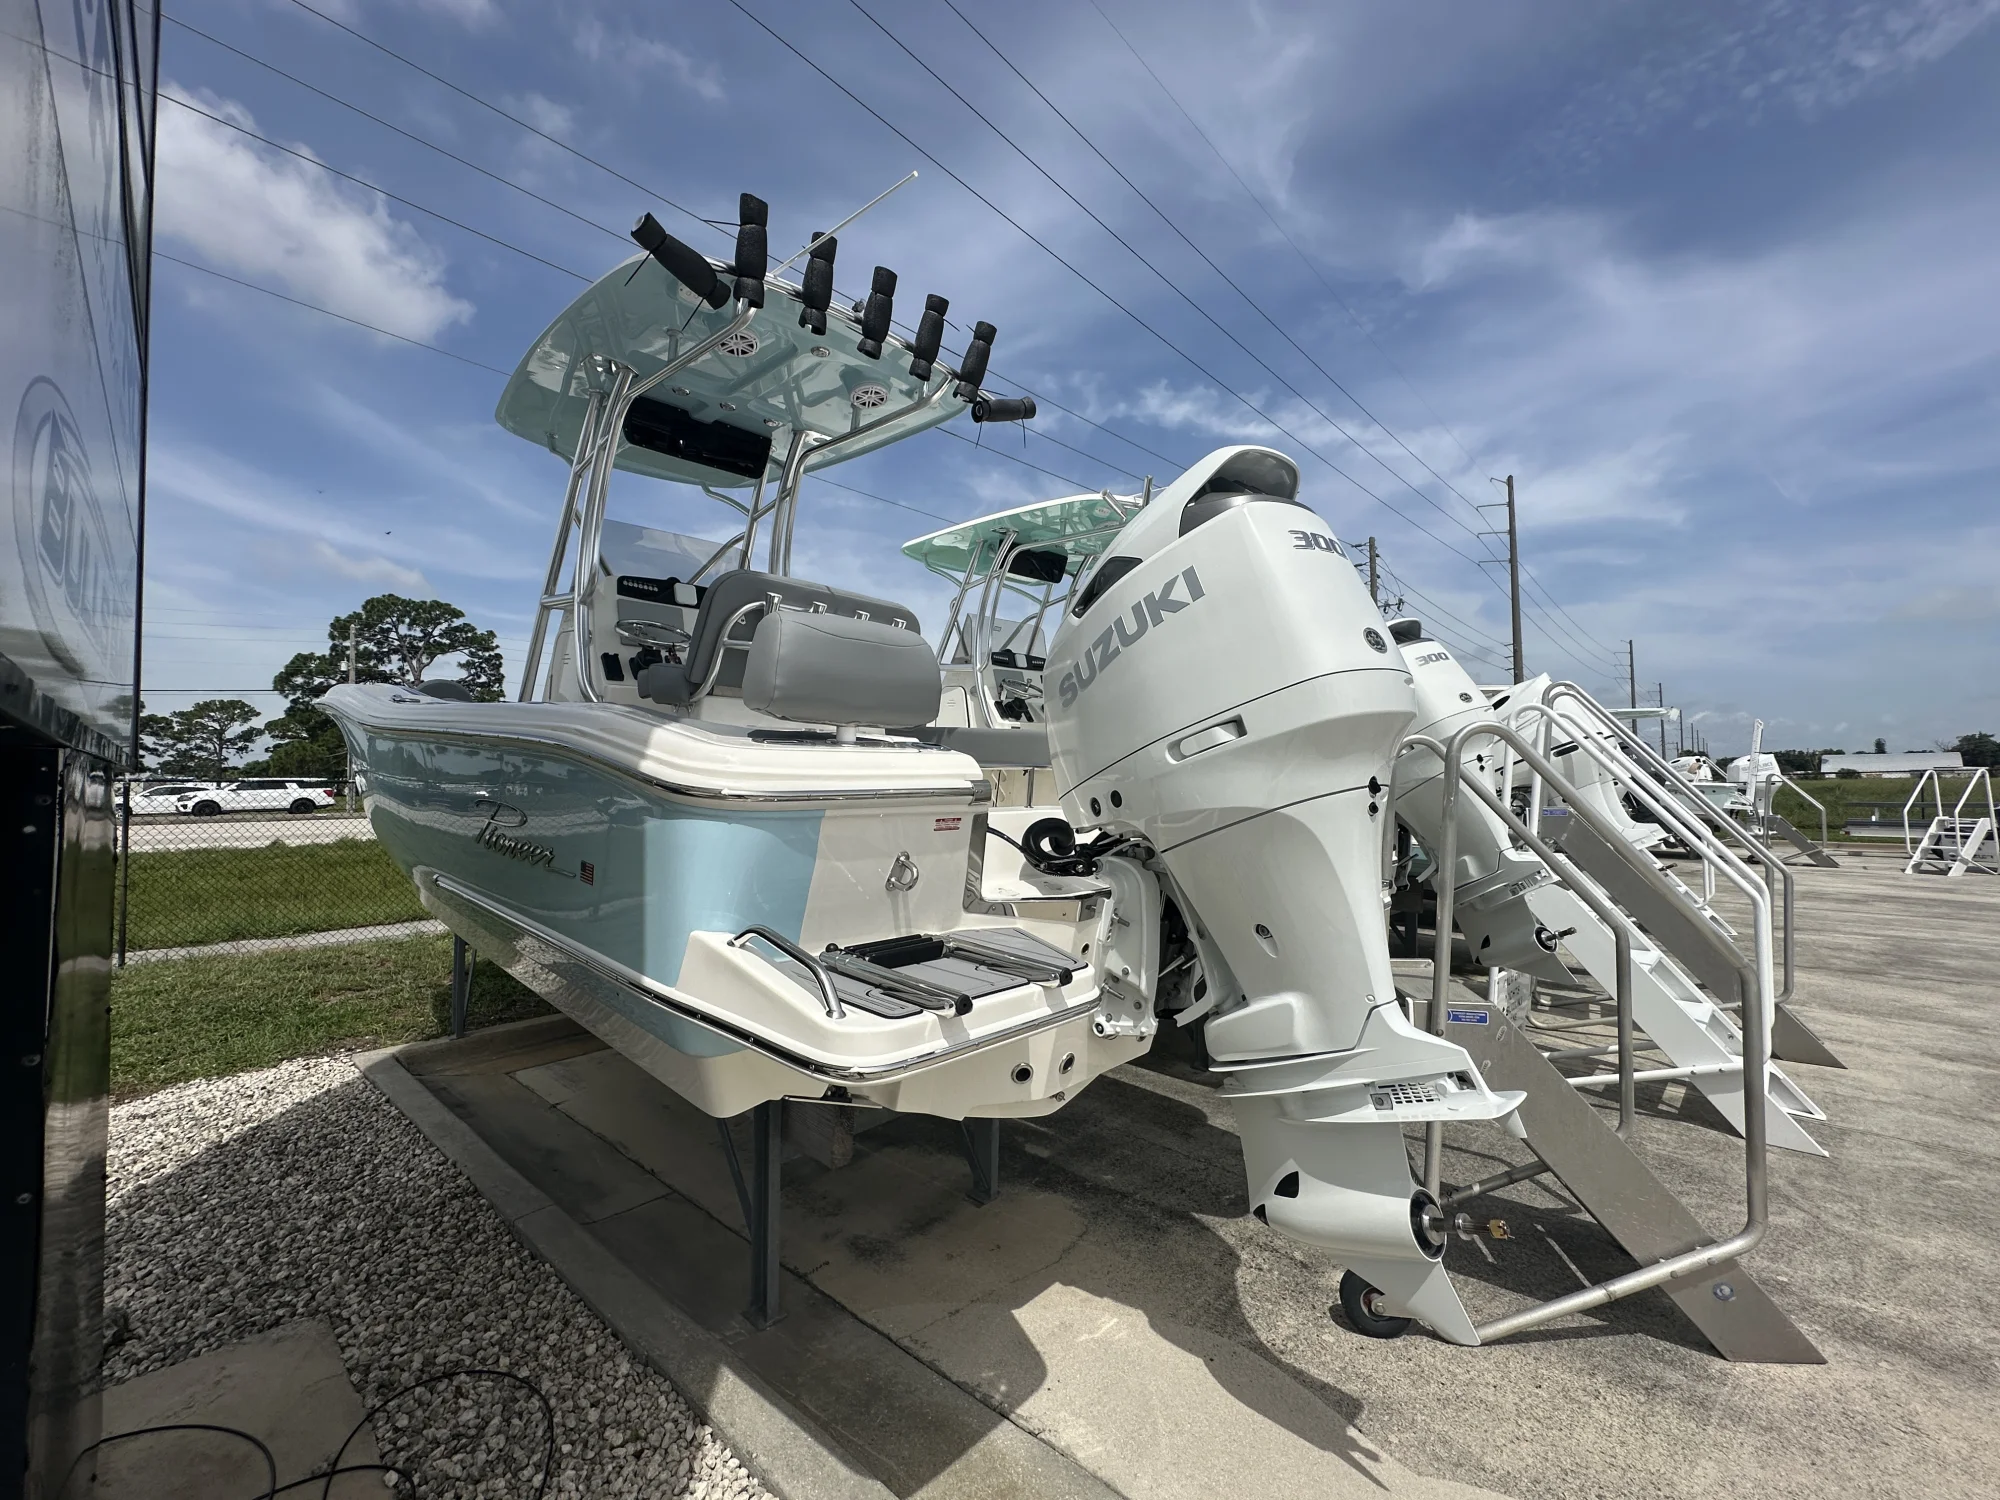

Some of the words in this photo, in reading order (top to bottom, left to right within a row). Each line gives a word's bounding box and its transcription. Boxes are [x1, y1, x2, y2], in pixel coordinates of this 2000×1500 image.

[1058, 564, 1206, 708] SUZUKI
[1415, 652, 1450, 667] 300
[475, 799, 576, 878] Pioneer
